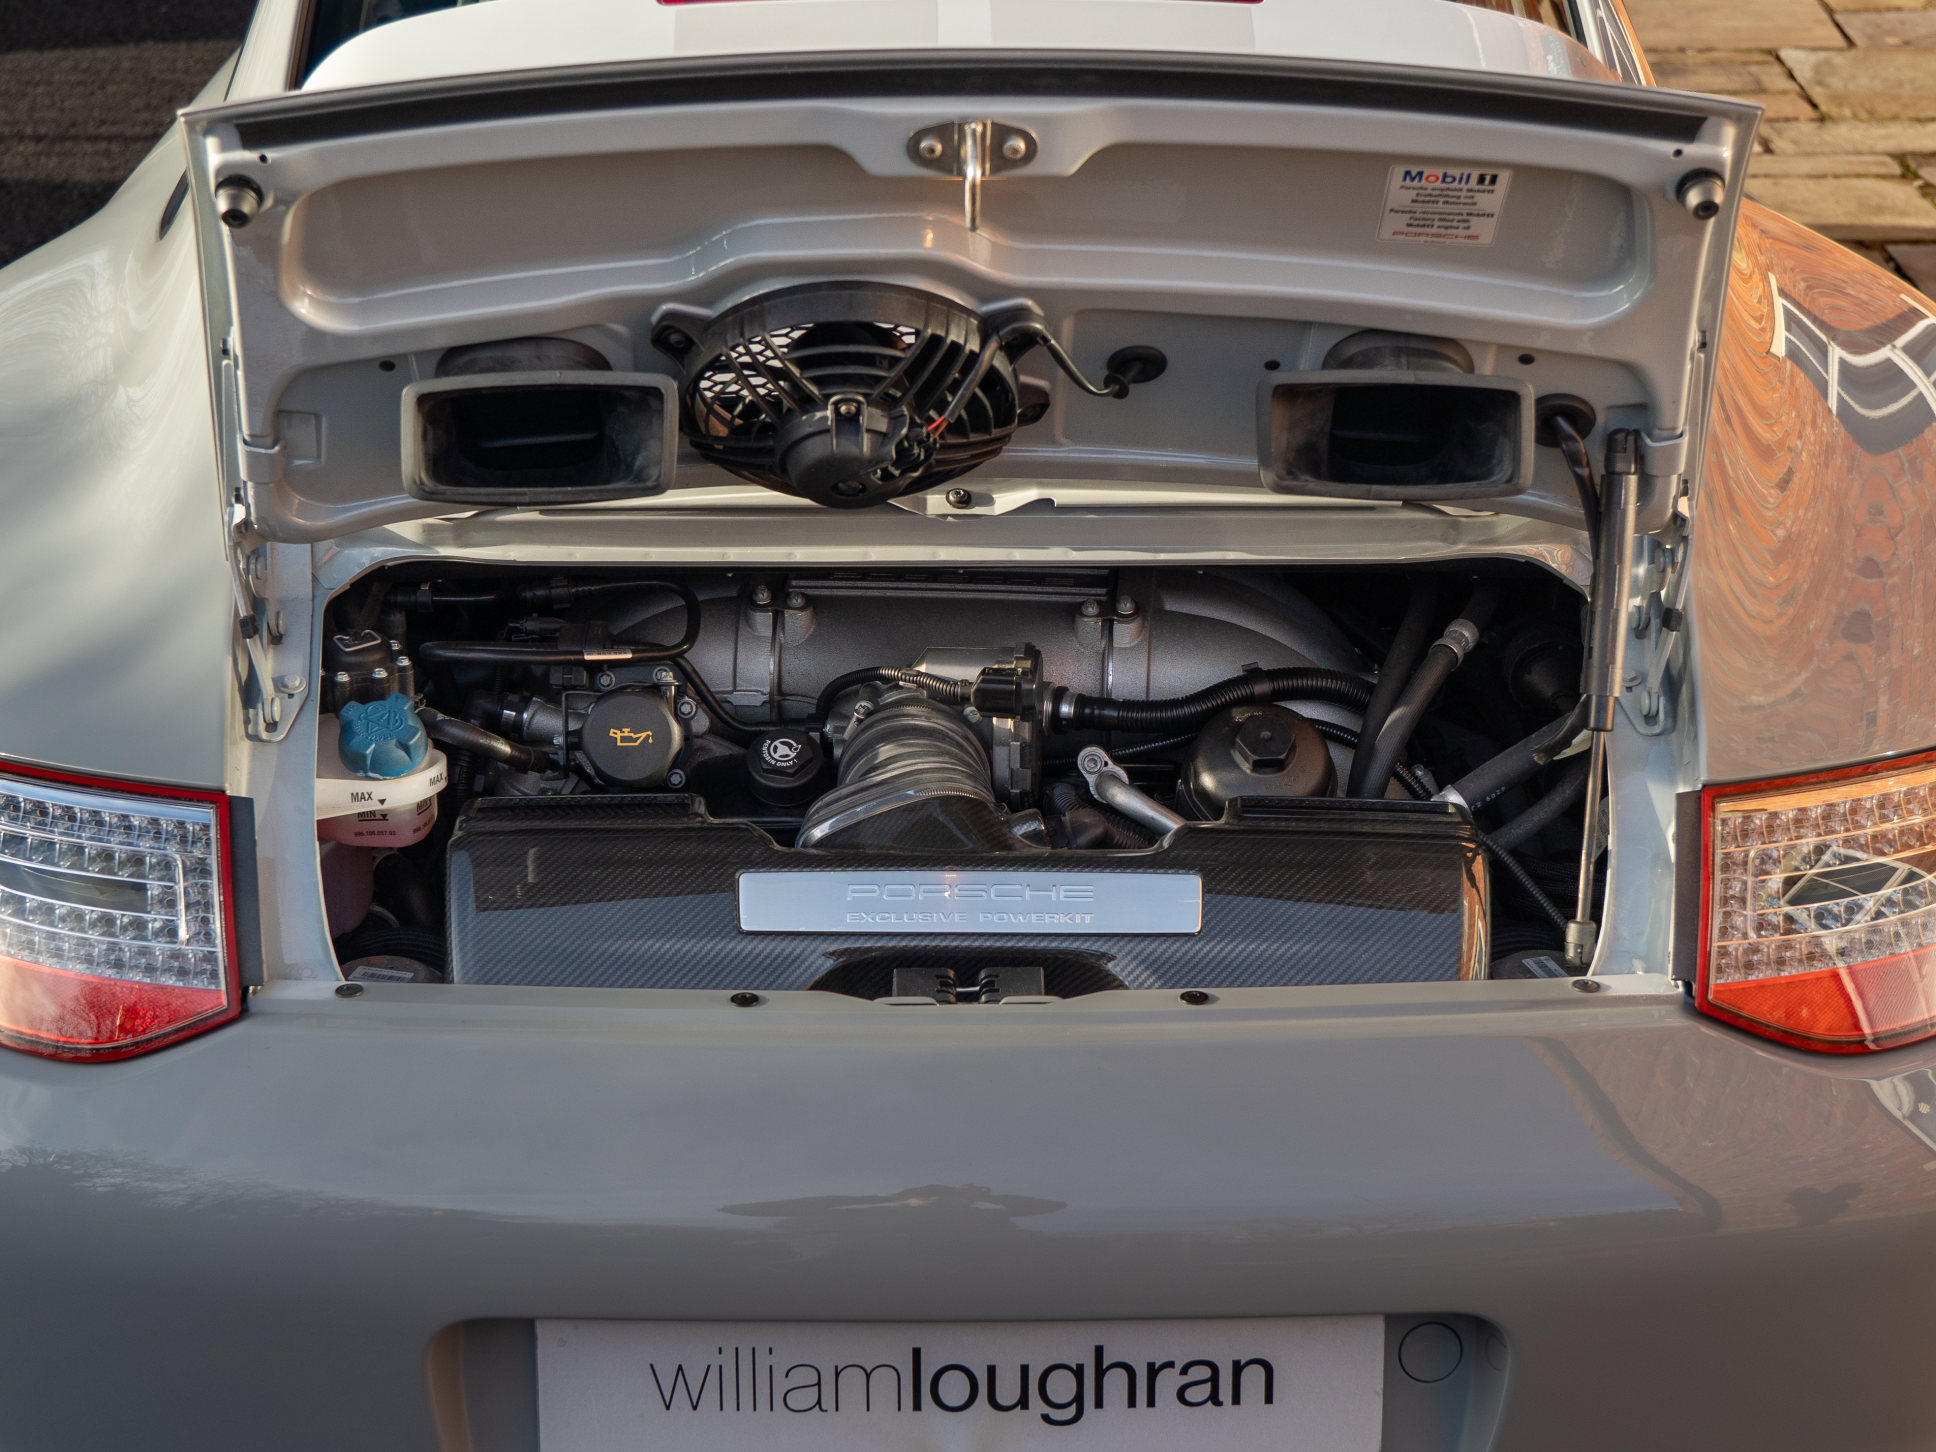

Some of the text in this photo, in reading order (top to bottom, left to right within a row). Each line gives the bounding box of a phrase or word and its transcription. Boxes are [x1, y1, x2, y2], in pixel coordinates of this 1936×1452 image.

[1402, 169, 1473, 185] Mobil
[1392, 231, 1480, 241] PORSCHE
[762, 739, 776, 765] PENTOSIN
[429, 772, 445, 788] MAX
[350, 791, 373, 803] MAX
[357, 810, 377, 819] MIN
[847, 883, 1095, 901] PORSCHE
[846, 911, 1095, 924] EXCLUSIVE POWERKIT
